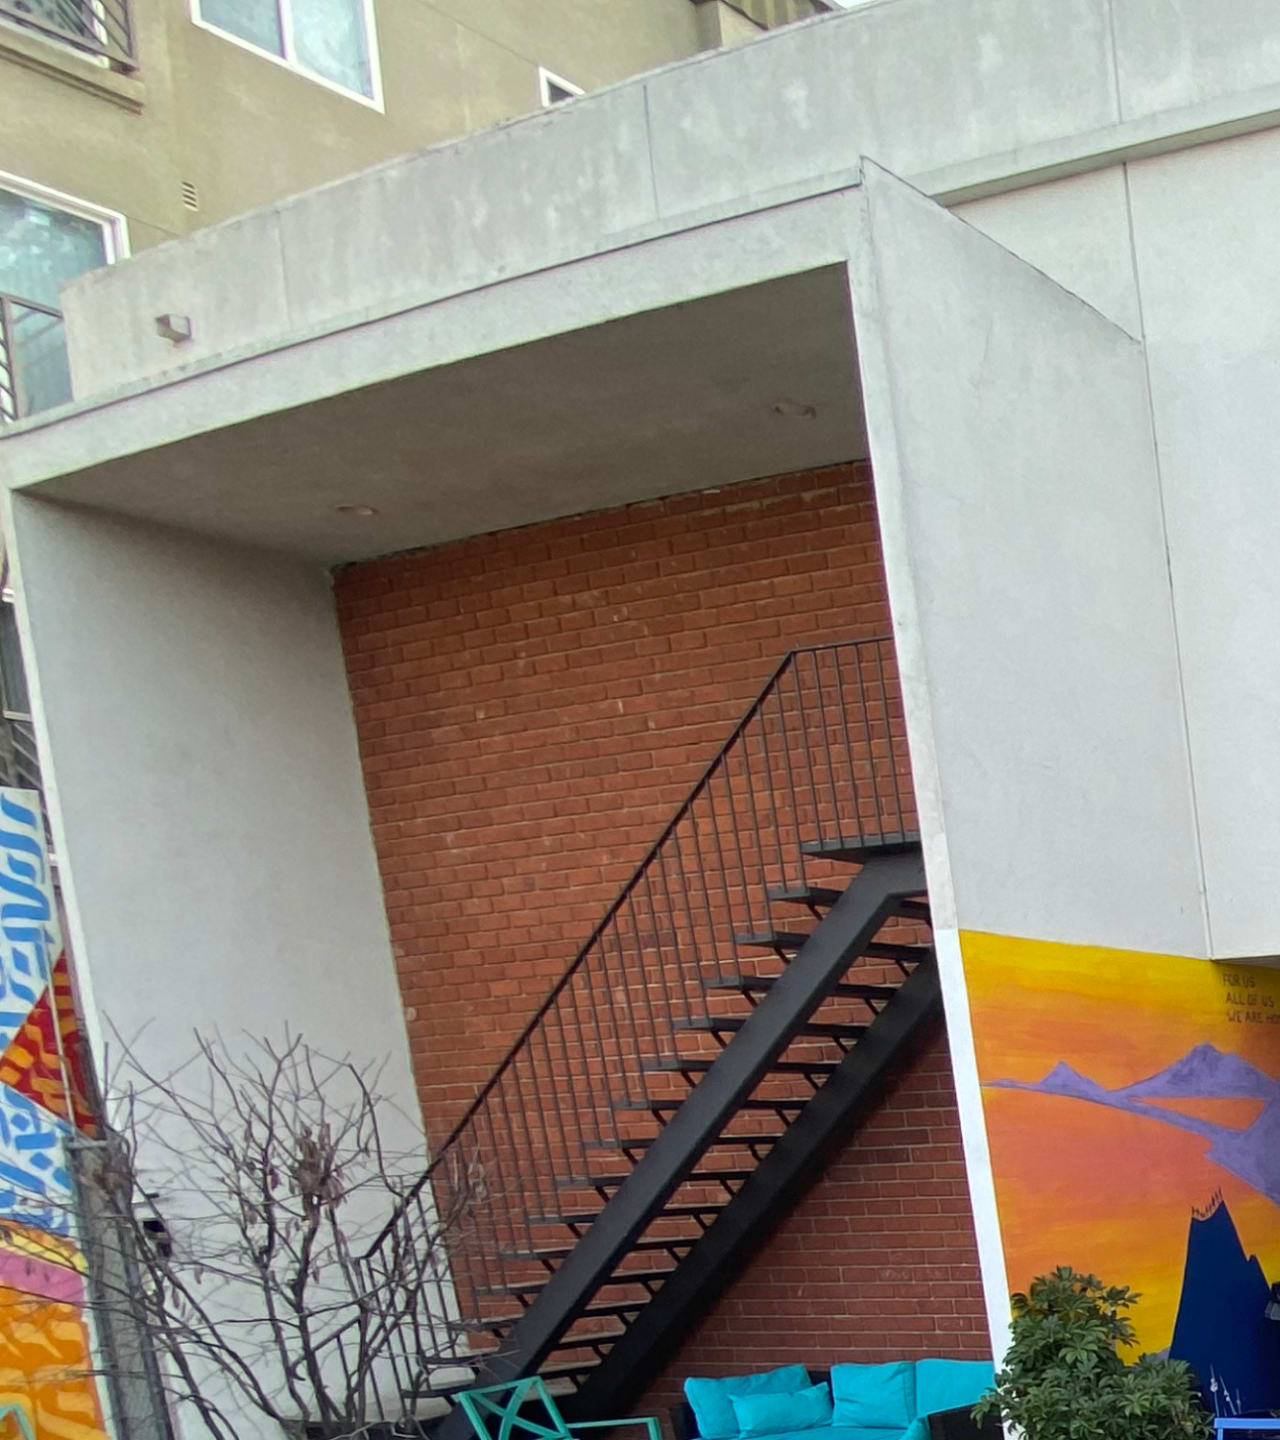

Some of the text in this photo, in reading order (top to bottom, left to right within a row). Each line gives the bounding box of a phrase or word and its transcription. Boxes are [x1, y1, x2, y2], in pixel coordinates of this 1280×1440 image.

[1243, 974, 1256, 989] US
[1226, 991, 1246, 1006] ALL
[1263, 995, 1275, 1009] US
